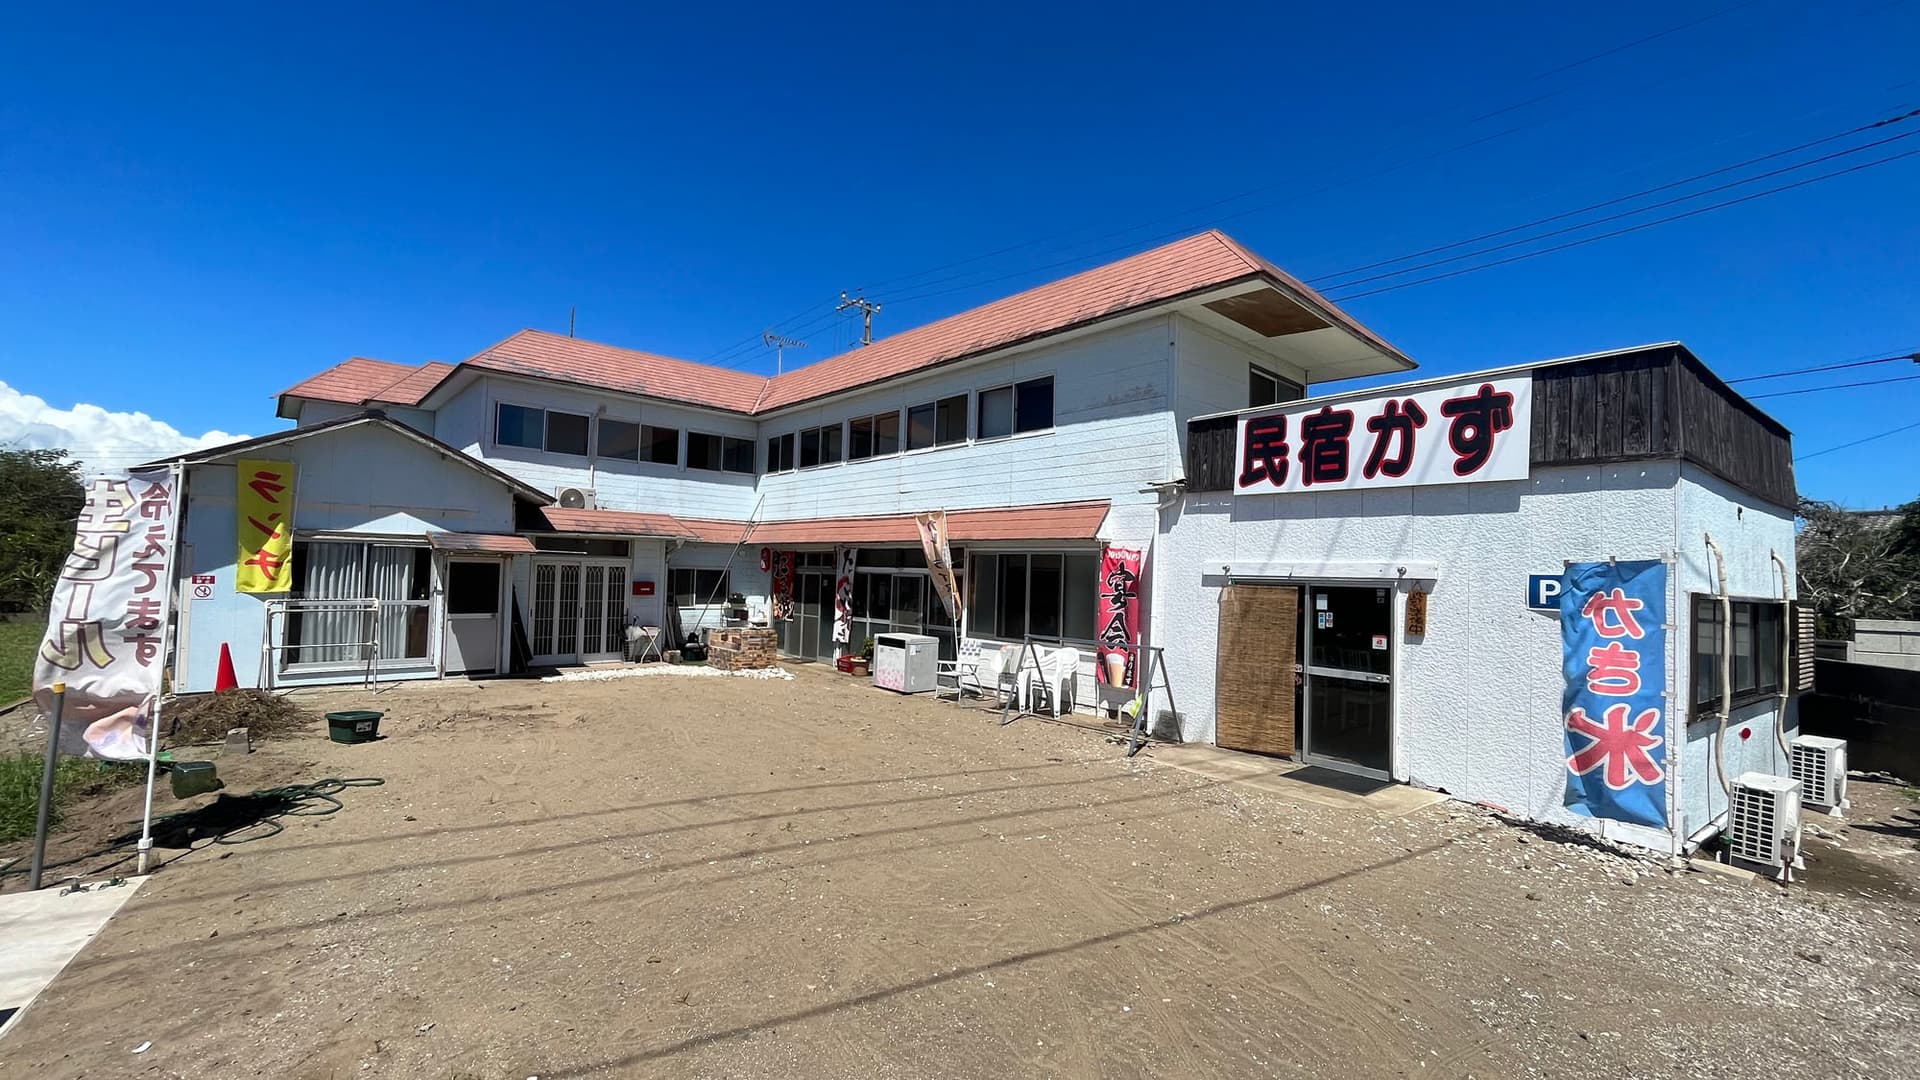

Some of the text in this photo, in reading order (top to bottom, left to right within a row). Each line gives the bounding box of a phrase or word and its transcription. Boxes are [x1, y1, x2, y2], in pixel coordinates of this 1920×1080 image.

[1239, 384, 1514, 487] 民宿かず
[1100, 561, 1136, 652] 宴会
[1539, 579, 1561, 605] P
